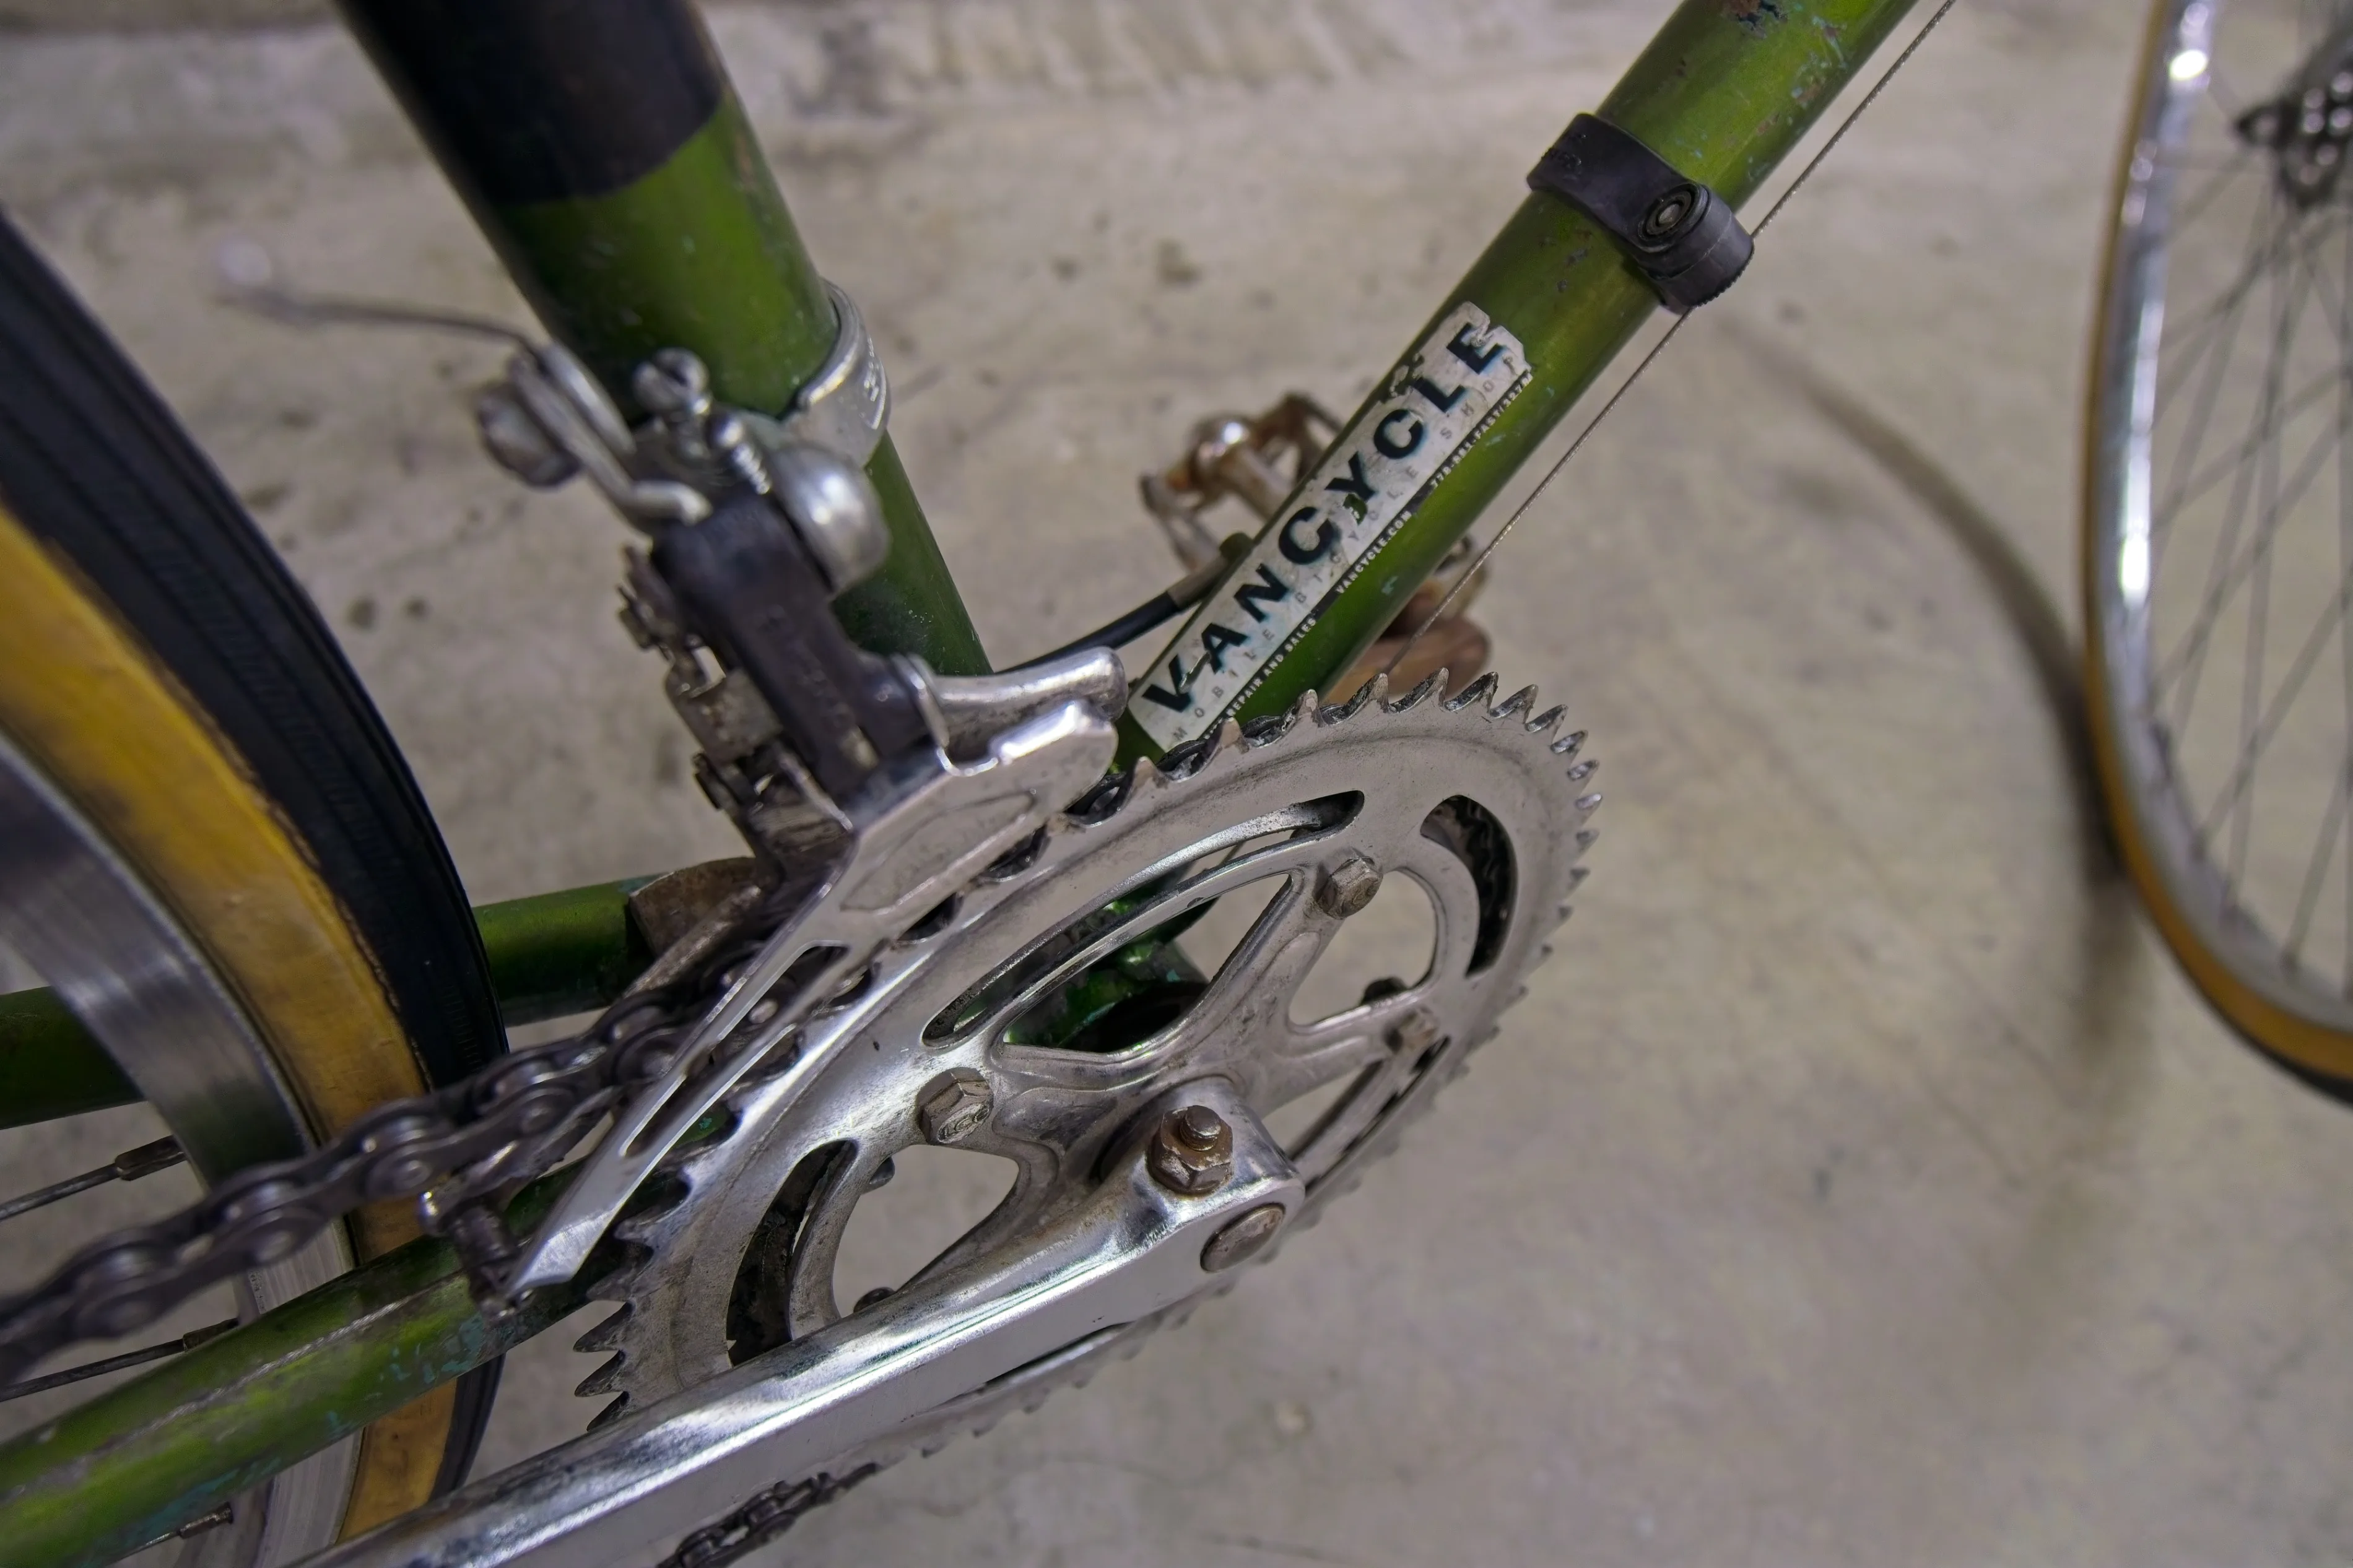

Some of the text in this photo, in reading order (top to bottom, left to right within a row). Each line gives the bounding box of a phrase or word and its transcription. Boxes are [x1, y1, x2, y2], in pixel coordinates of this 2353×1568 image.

[1142, 323, 1507, 713] VANCYCLE
[1173, 354, 1514, 740] MOBILE BICYCLE SHOP
[1226, 678, 1263, 717] REPAIR
[1263, 654, 1284, 678] AND
[1284, 618, 1316, 652] SALES
[1336, 511, 1412, 594] VANCYCLE.COM
